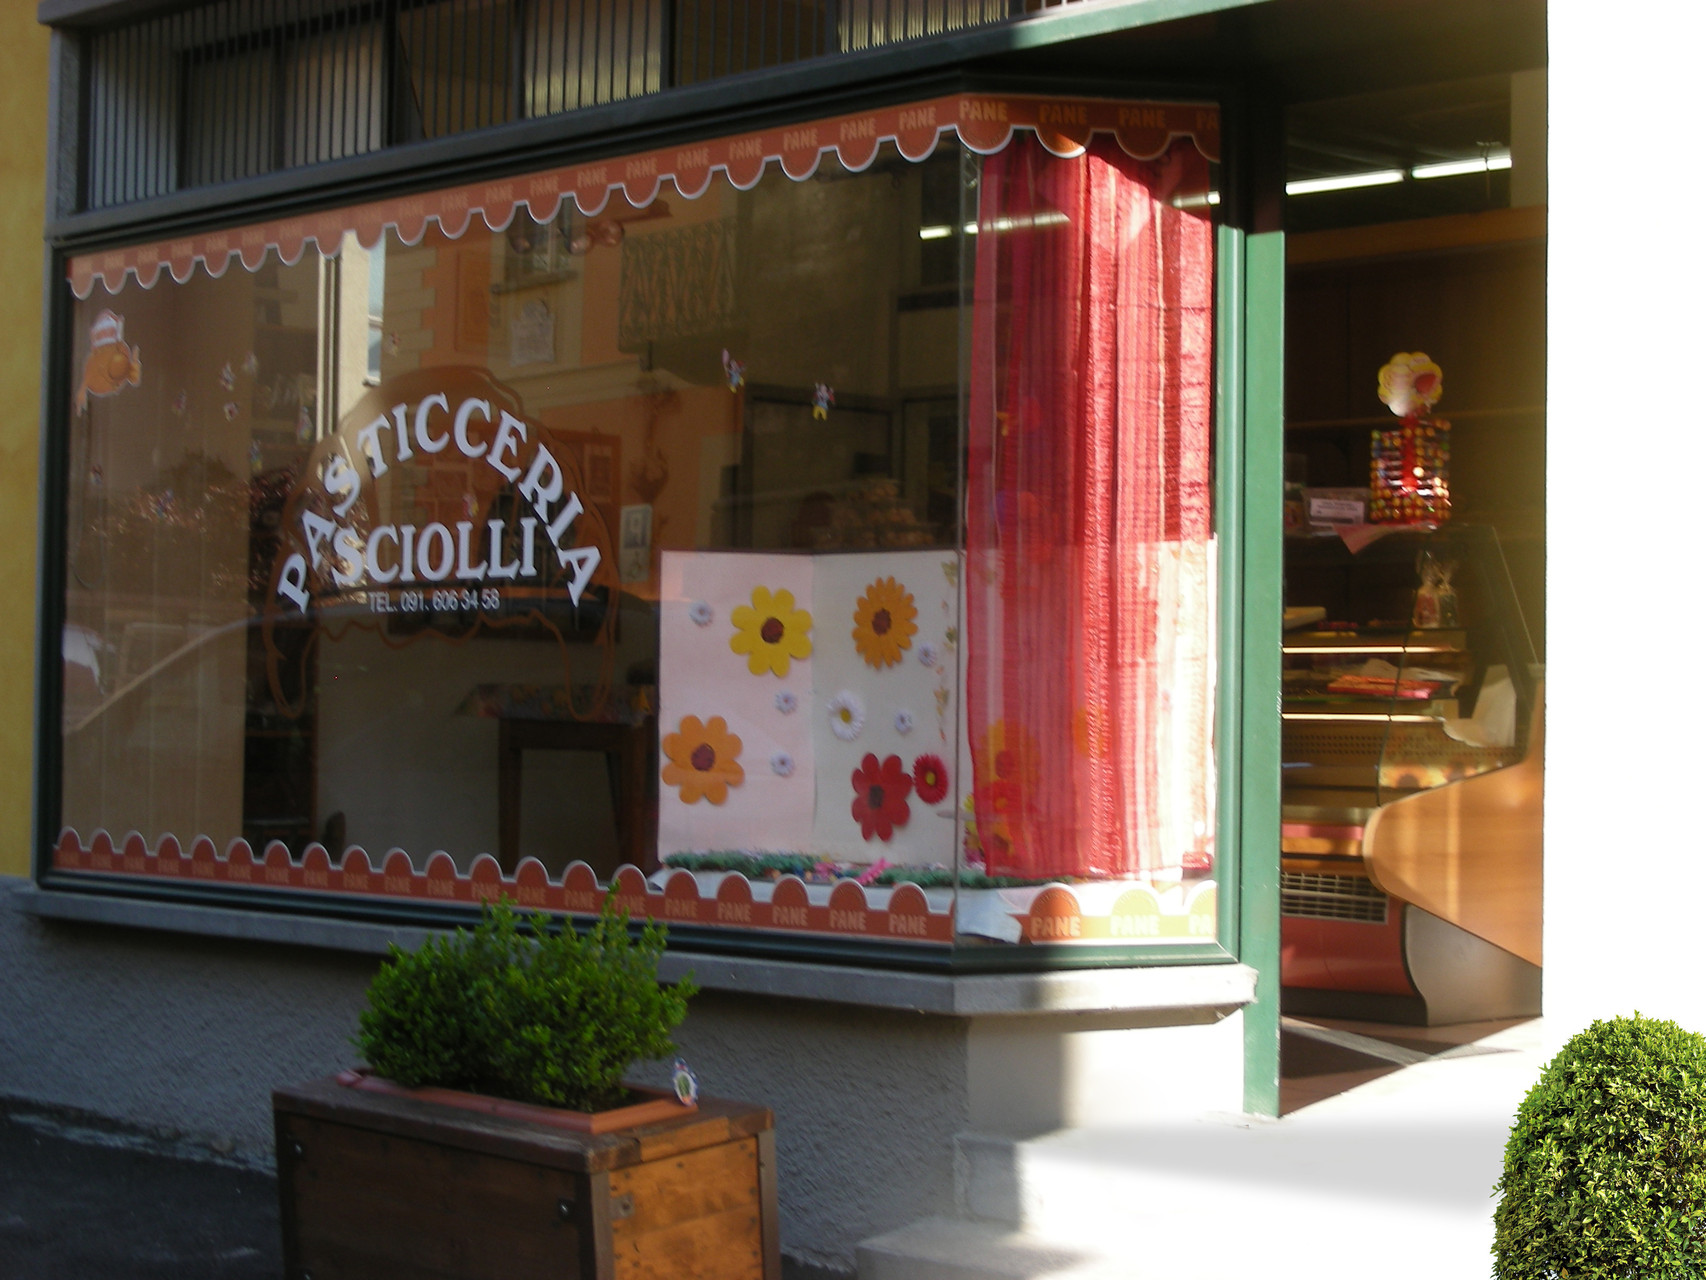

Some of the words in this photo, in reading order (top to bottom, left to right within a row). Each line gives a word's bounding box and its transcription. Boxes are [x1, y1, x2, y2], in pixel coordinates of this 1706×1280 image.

[784, 128, 818, 151] PANE
[840, 118, 876, 141] PANE
[899, 106, 936, 131] PANE
[959, 100, 1008, 121] PANE
[1039, 104, 1088, 124] PANE
[1119, 107, 1166, 128] PANE
[277, 392, 601, 614] PASTICCERIA
[331, 517, 537, 585] SCIOLLI
[368, 591, 397, 612] TEL.
[432, 589, 458, 611] 606
[482, 588, 500, 609] 58
[717, 901, 751, 922] PANE
[772, 905, 808, 927] PANE
[829, 909, 866, 931] PANE
[889, 913, 927, 935] PANE
[1030, 916, 1081, 937] PANE
[1110, 915, 1160, 936] PANE
